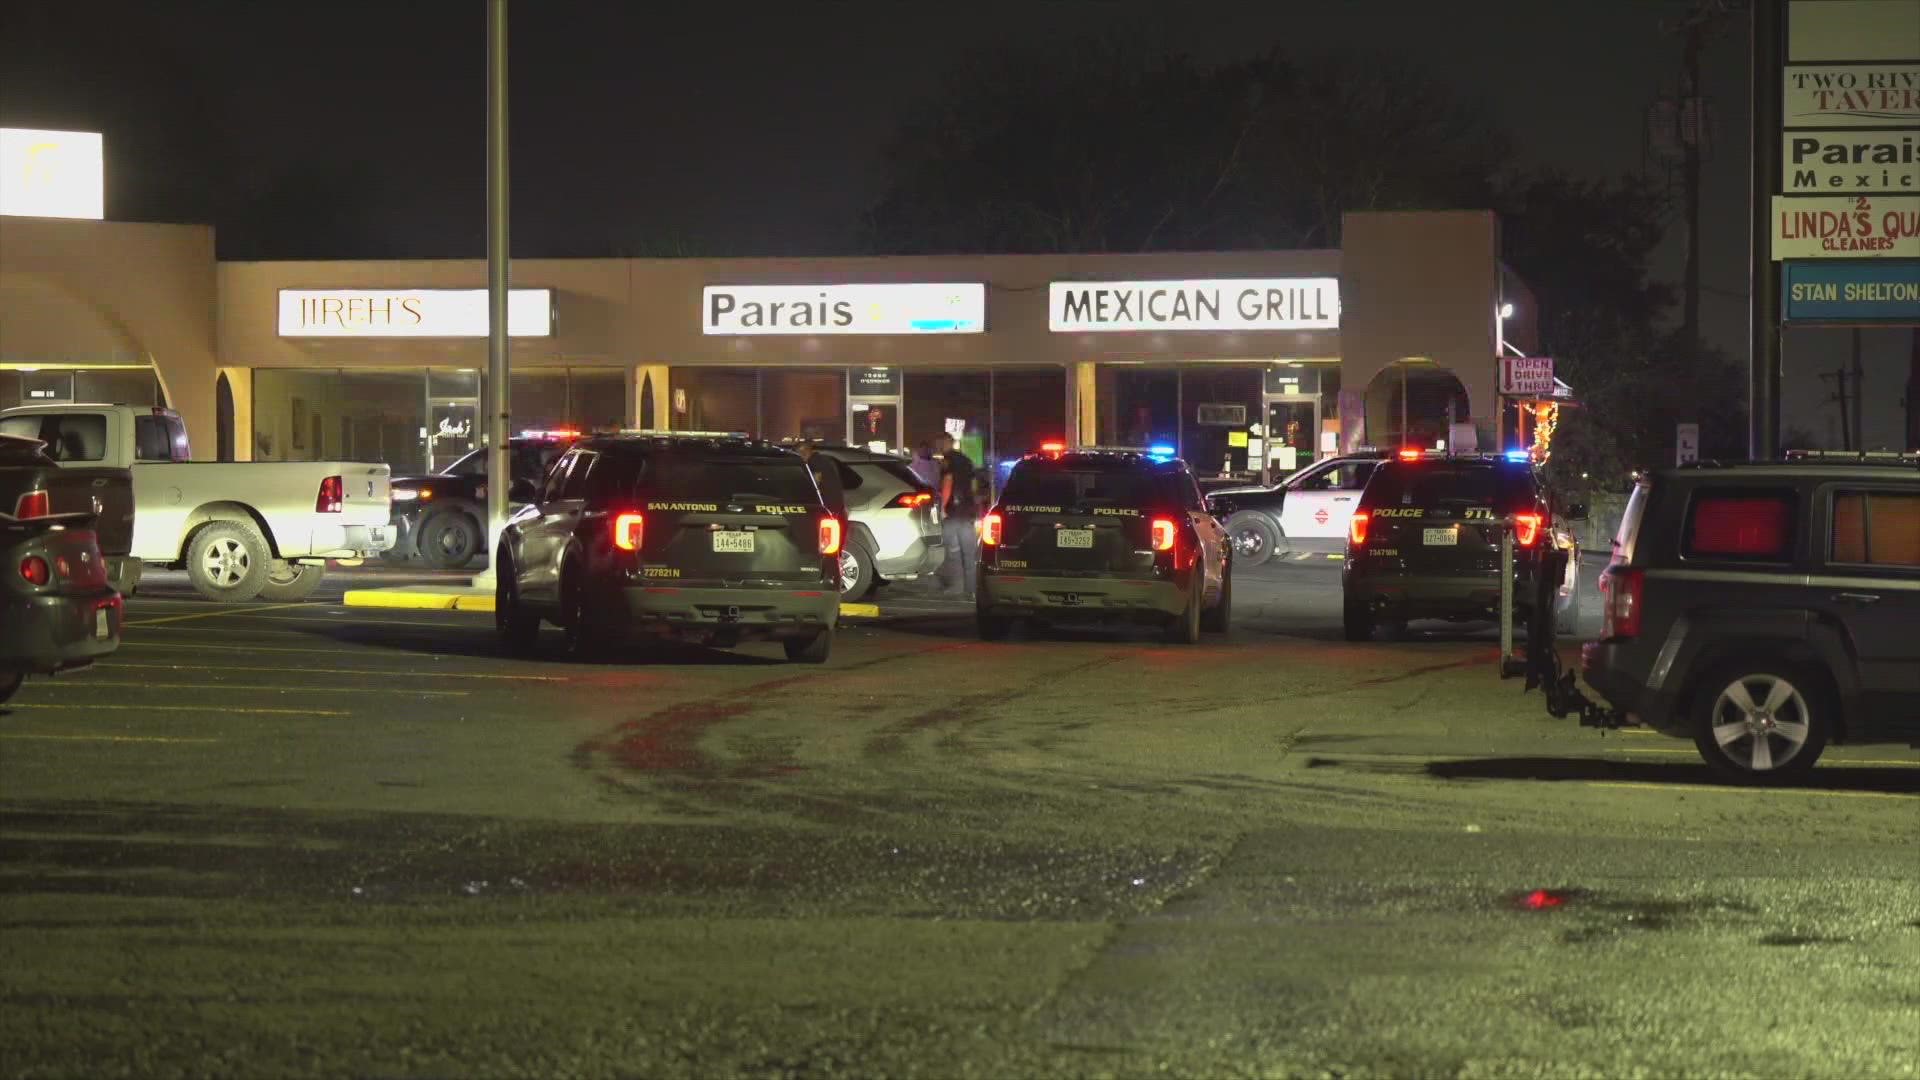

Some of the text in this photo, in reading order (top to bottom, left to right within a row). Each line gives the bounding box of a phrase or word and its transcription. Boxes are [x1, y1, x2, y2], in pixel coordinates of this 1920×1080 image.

[1793, 73, 1857, 89] TWO
[1792, 137, 1920, 164] Parai
[1793, 169, 1912, 187] Mexic
[1781, 211, 1872, 238] LINDA'S
[1822, 237, 1895, 251] CLEANERS
[1792, 283, 1837, 301] STAN
[1063, 288, 1330, 323] MEXICAN GRILL
[1516, 358, 1549, 369] OPEN
[1514, 370, 1552, 380] DRIVE
[1516, 381, 1550, 391] THRU
[648, 503, 807, 514] SAN ANTONIO POLICE
[1005, 504, 1139, 516] SAN ANTONIO POLICE
[1372, 508, 1424, 518] POLICE
[1464, 510, 1493, 519] 911
